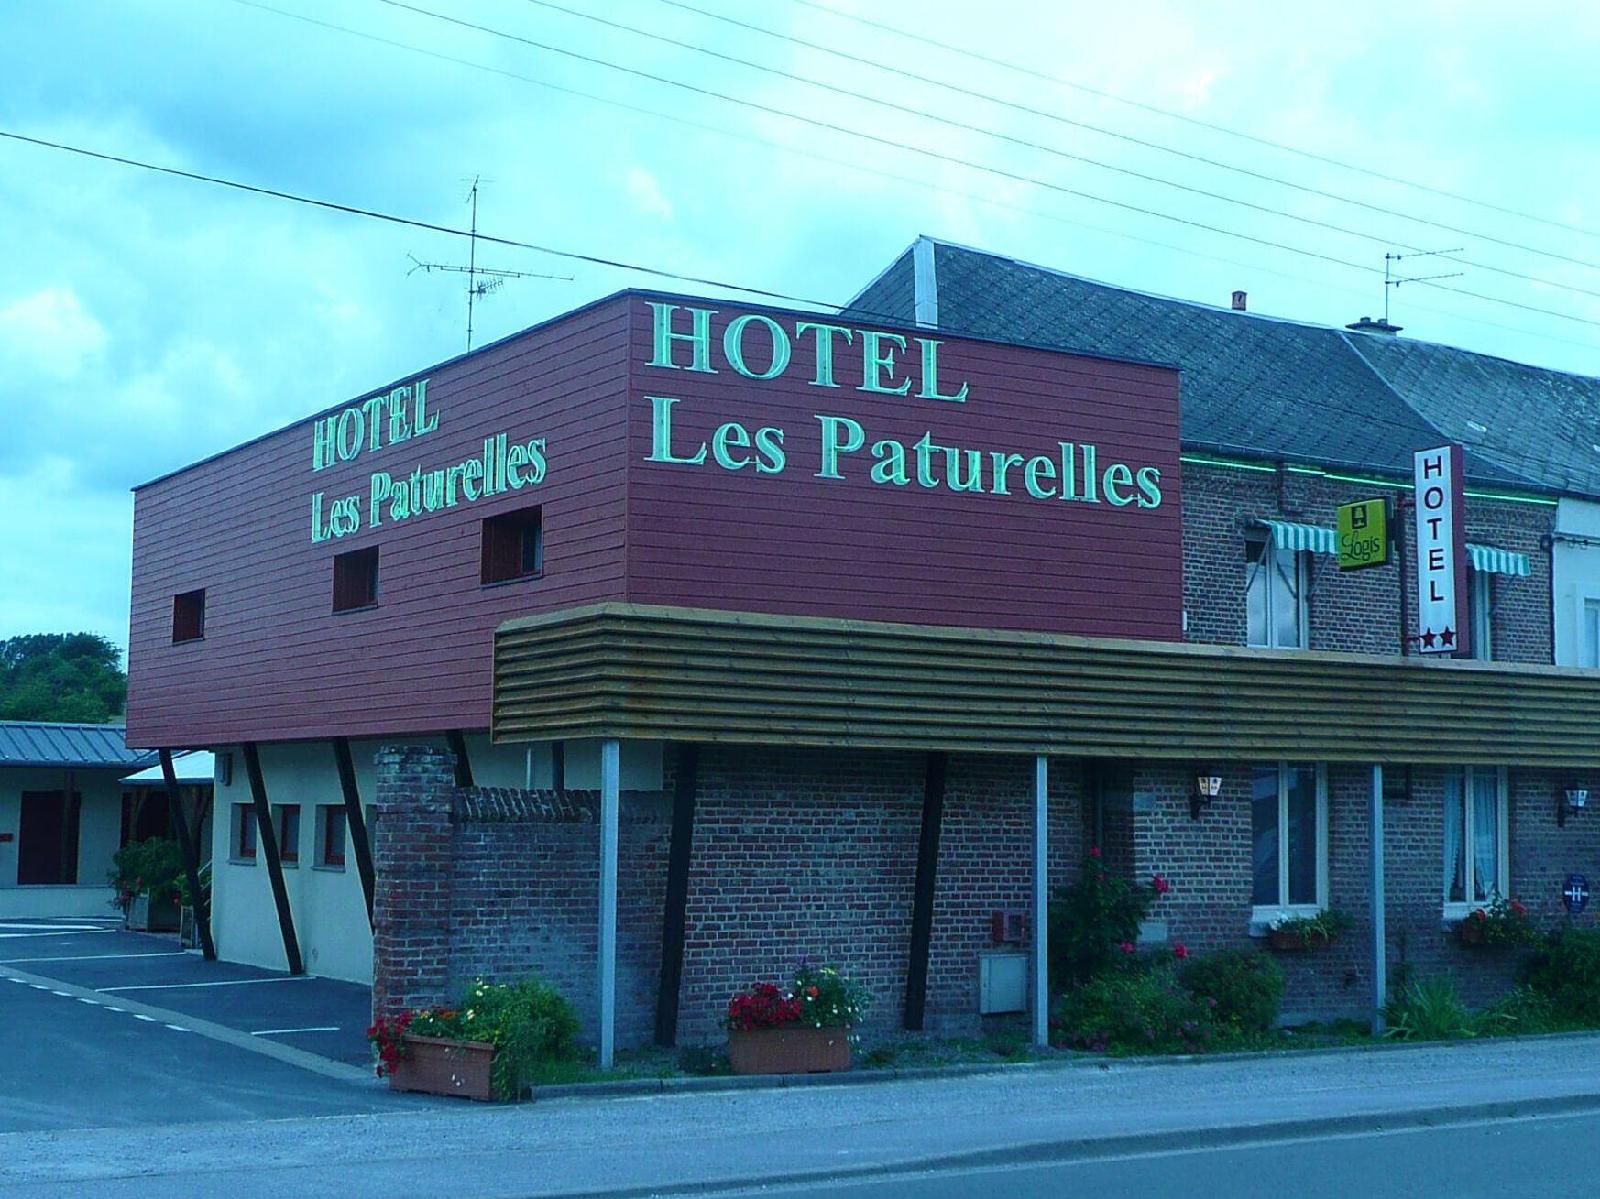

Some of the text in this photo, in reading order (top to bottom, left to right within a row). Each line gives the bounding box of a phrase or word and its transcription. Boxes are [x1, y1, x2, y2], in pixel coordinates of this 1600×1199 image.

[644, 301, 970, 403] HOTEL
[312, 378, 440, 472] HOTEL
[643, 396, 1163, 509] Les Paturelles
[311, 433, 547, 543] Les Paturelles
[1423, 455, 1445, 602] HOTEL
[1341, 530, 1380, 561] Logis
